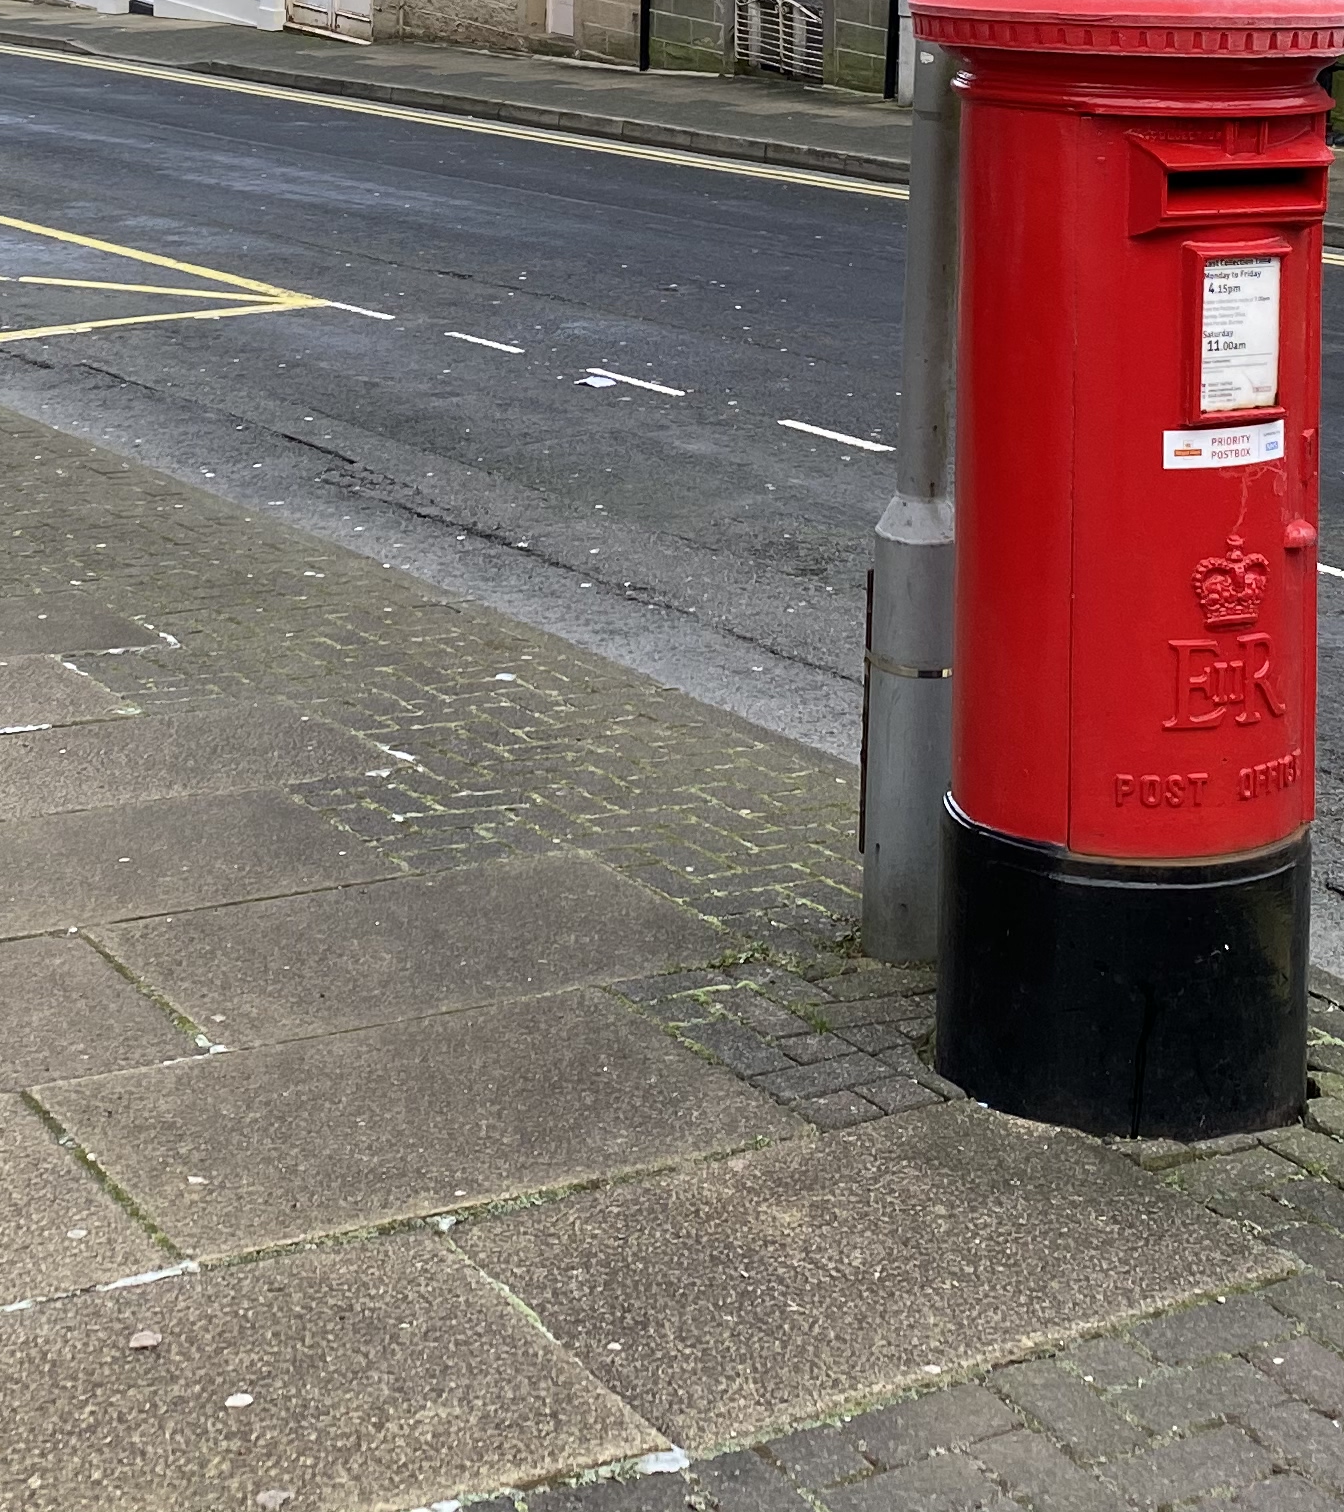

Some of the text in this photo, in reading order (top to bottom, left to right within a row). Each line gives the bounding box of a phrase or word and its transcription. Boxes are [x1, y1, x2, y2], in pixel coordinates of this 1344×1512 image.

[1203, 272, 1230, 280] Monday
[1240, 269, 1262, 279] Friday
[1202, 330, 1234, 340] Saturday
[1211, 434, 1251, 447] PRIORITY
[1211, 447, 1251, 460] POSTBOX
[1114, 773, 1209, 808] POST
